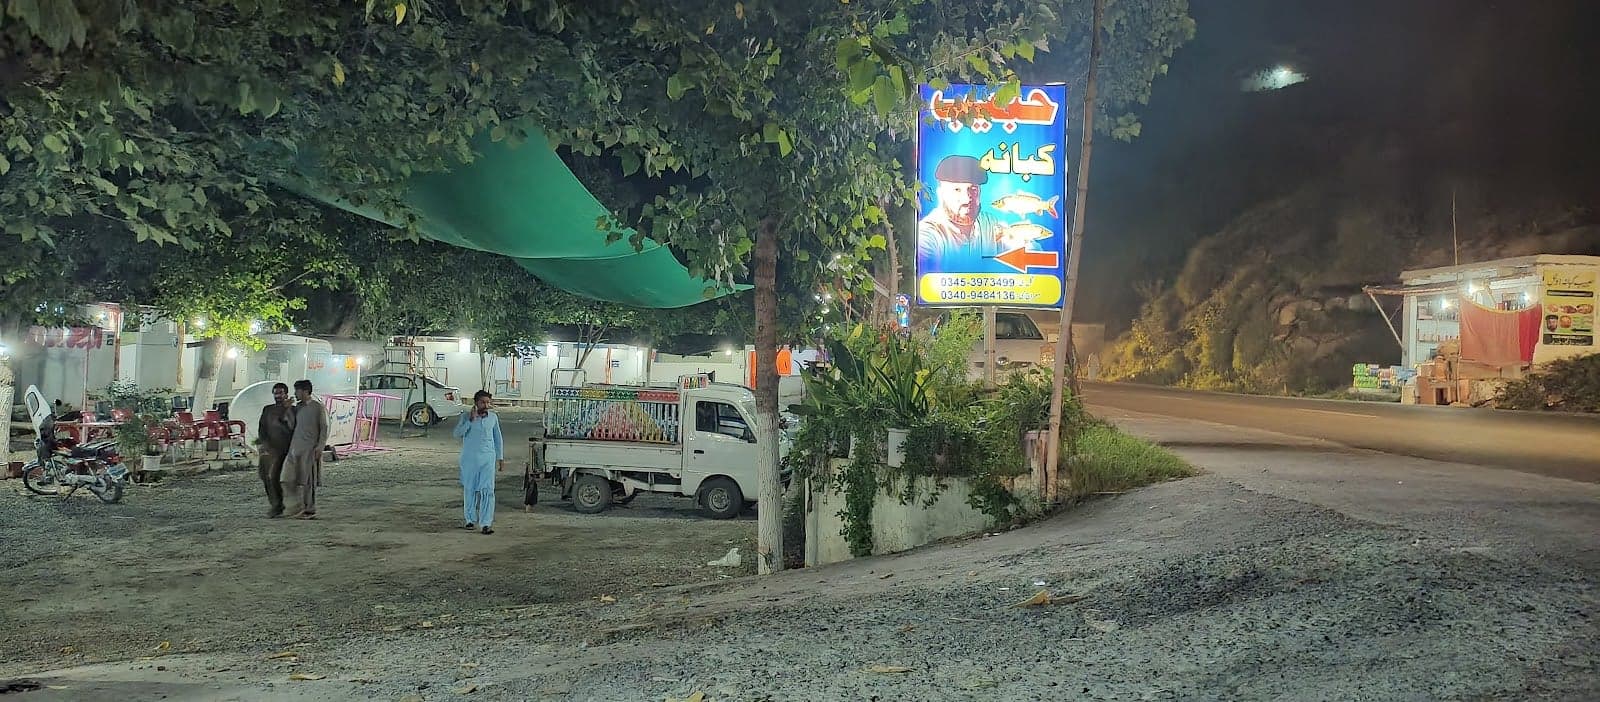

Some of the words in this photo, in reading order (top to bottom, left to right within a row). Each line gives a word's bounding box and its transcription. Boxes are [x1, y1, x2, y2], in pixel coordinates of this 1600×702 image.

[930, 89, 1059, 134] حبیب
[940, 277, 1015, 287] 0345-3973499
[940, 290, 1015, 300] 0340-9484136
